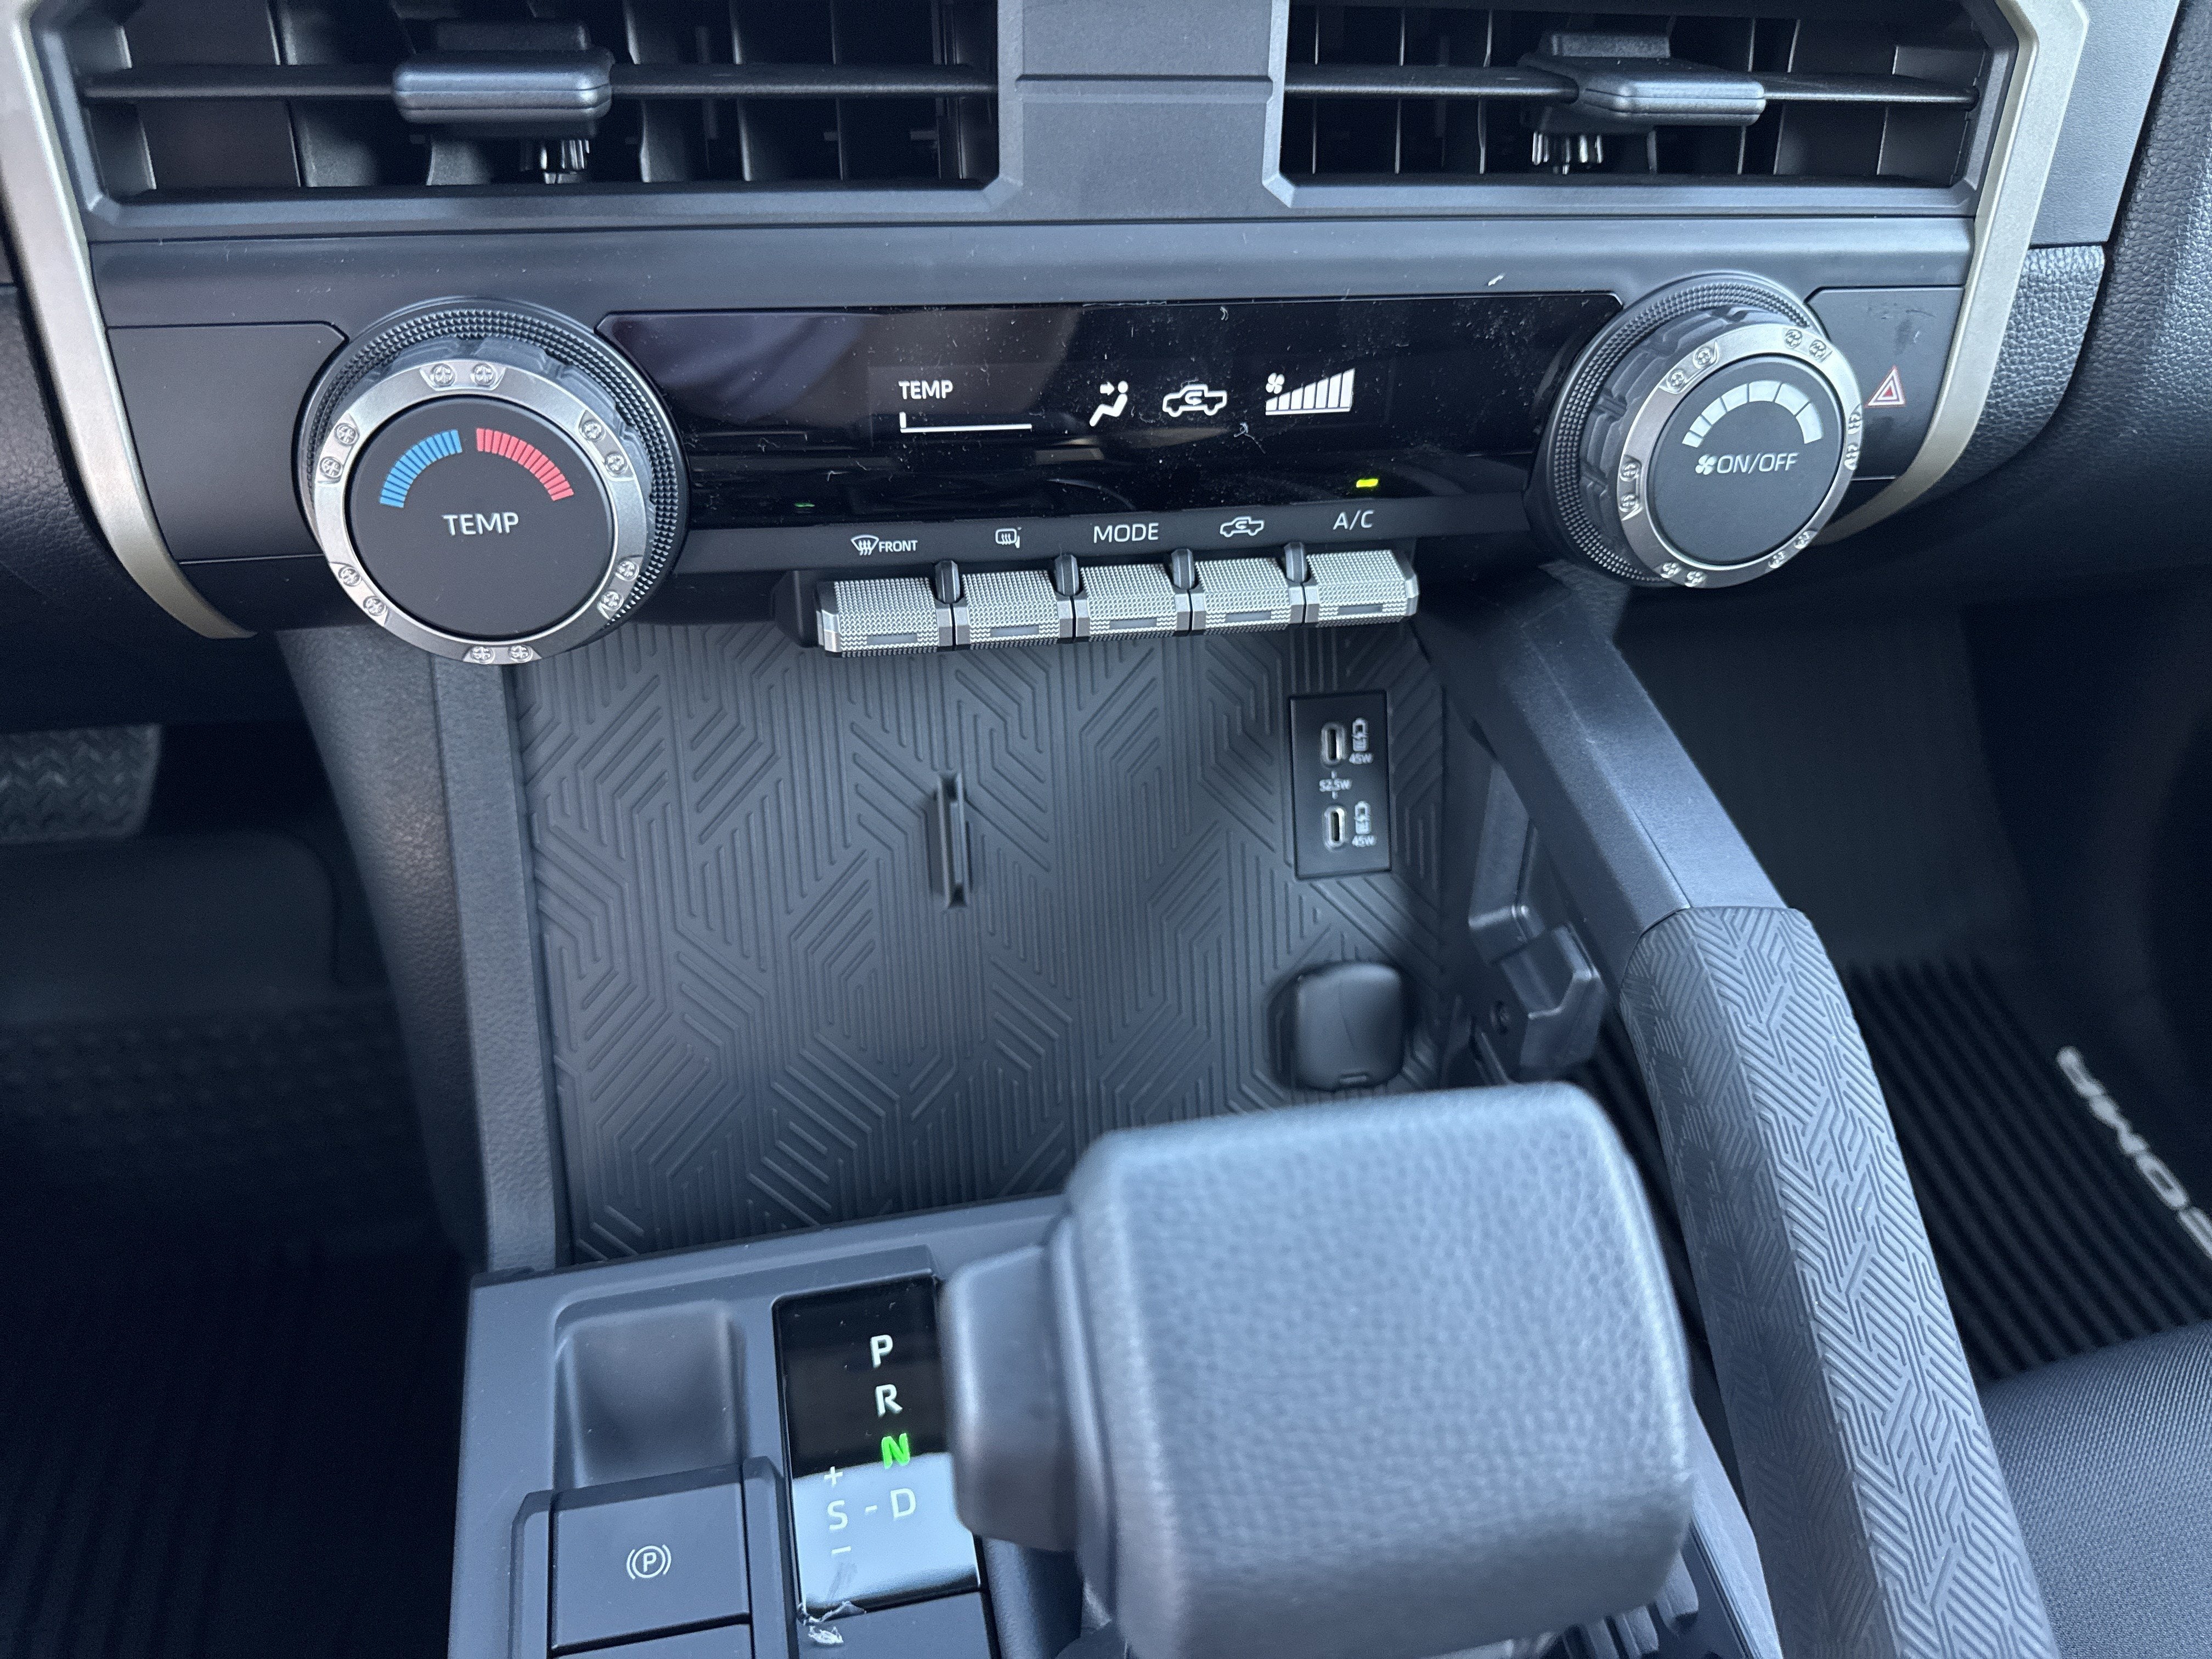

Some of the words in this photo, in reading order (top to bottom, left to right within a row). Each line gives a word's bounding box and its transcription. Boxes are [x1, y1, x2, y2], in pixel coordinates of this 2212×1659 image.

[898, 379, 954, 400] TEMP
[1717, 451, 1799, 475] ON/OFF
[443, 511, 520, 536] TEMP
[1333, 509, 1374, 531] A/C
[1093, 522, 1159, 544] MODE
[878, 539, 918, 552] FRONT
[1348, 752, 1374, 765] 45W
[1351, 834, 1377, 848] 45W
[870, 1334, 894, 1368] P
[874, 1383, 903, 1417] R
[881, 1433, 911, 1469] N
[827, 1499, 849, 1531] S
[890, 1487, 917, 1520] D
